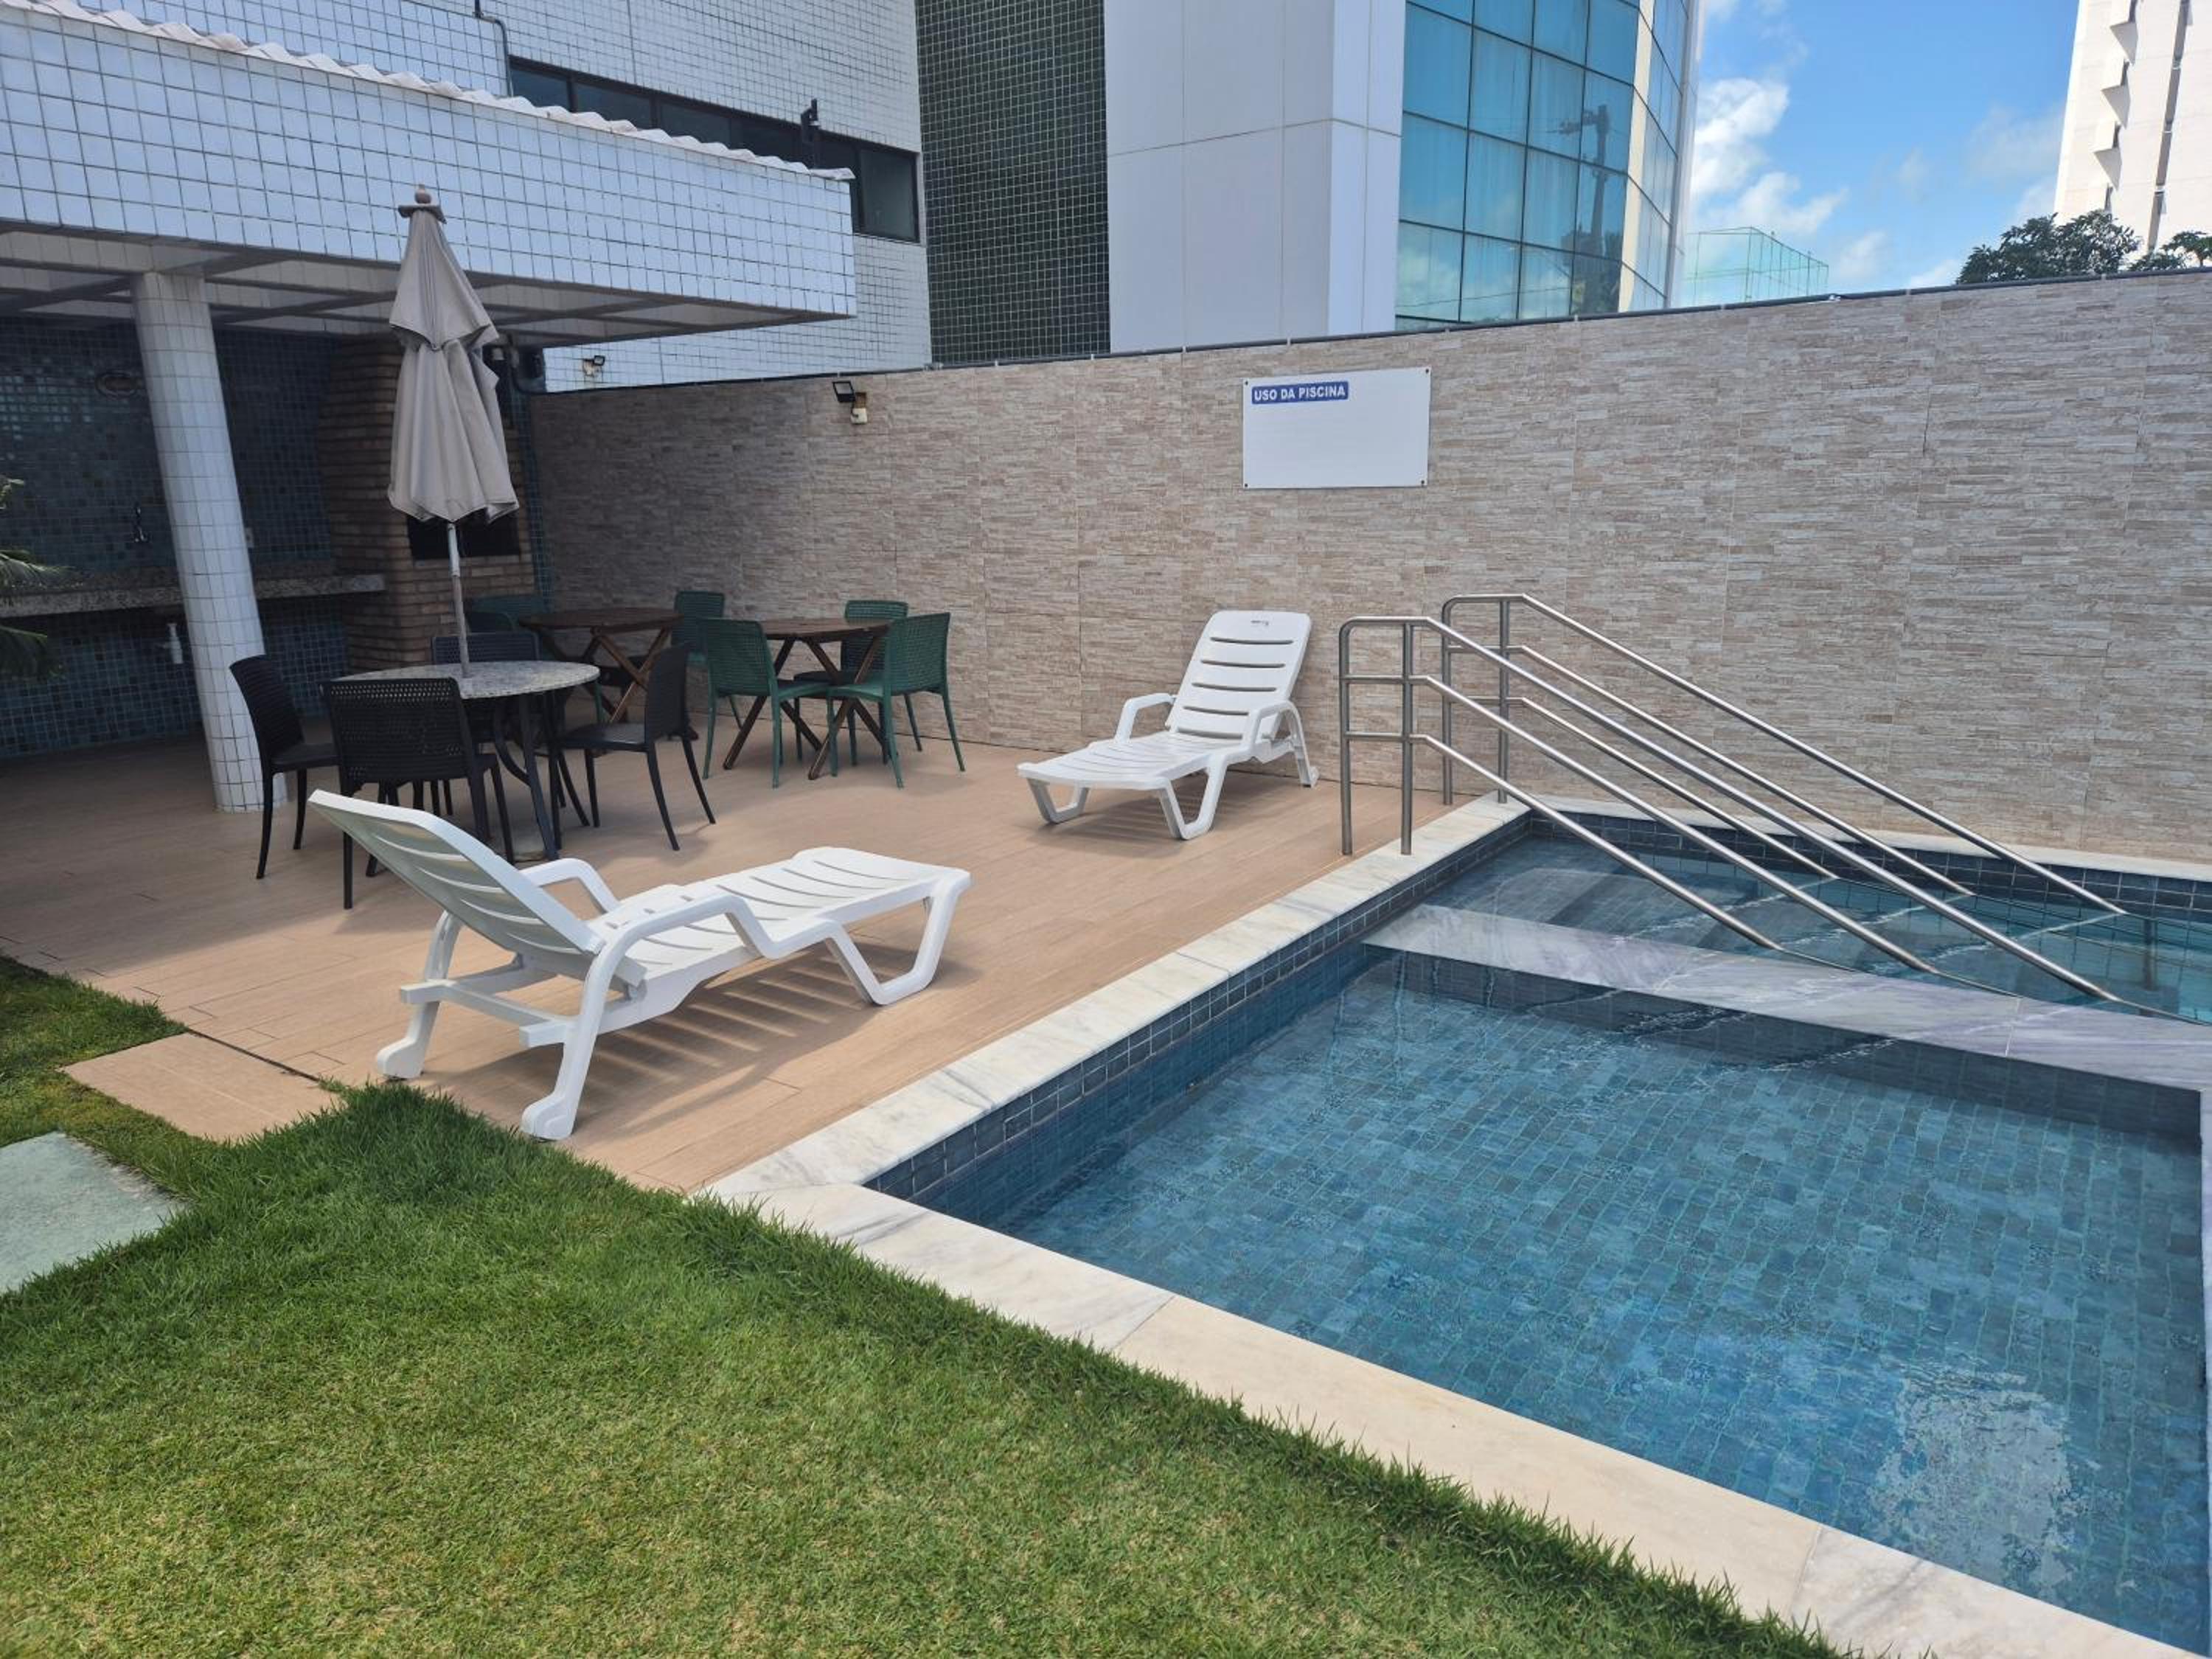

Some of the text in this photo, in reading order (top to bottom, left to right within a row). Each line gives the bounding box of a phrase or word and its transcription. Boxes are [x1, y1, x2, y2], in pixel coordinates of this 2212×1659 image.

[1253, 385, 1346, 400] USO DA PISCINA
